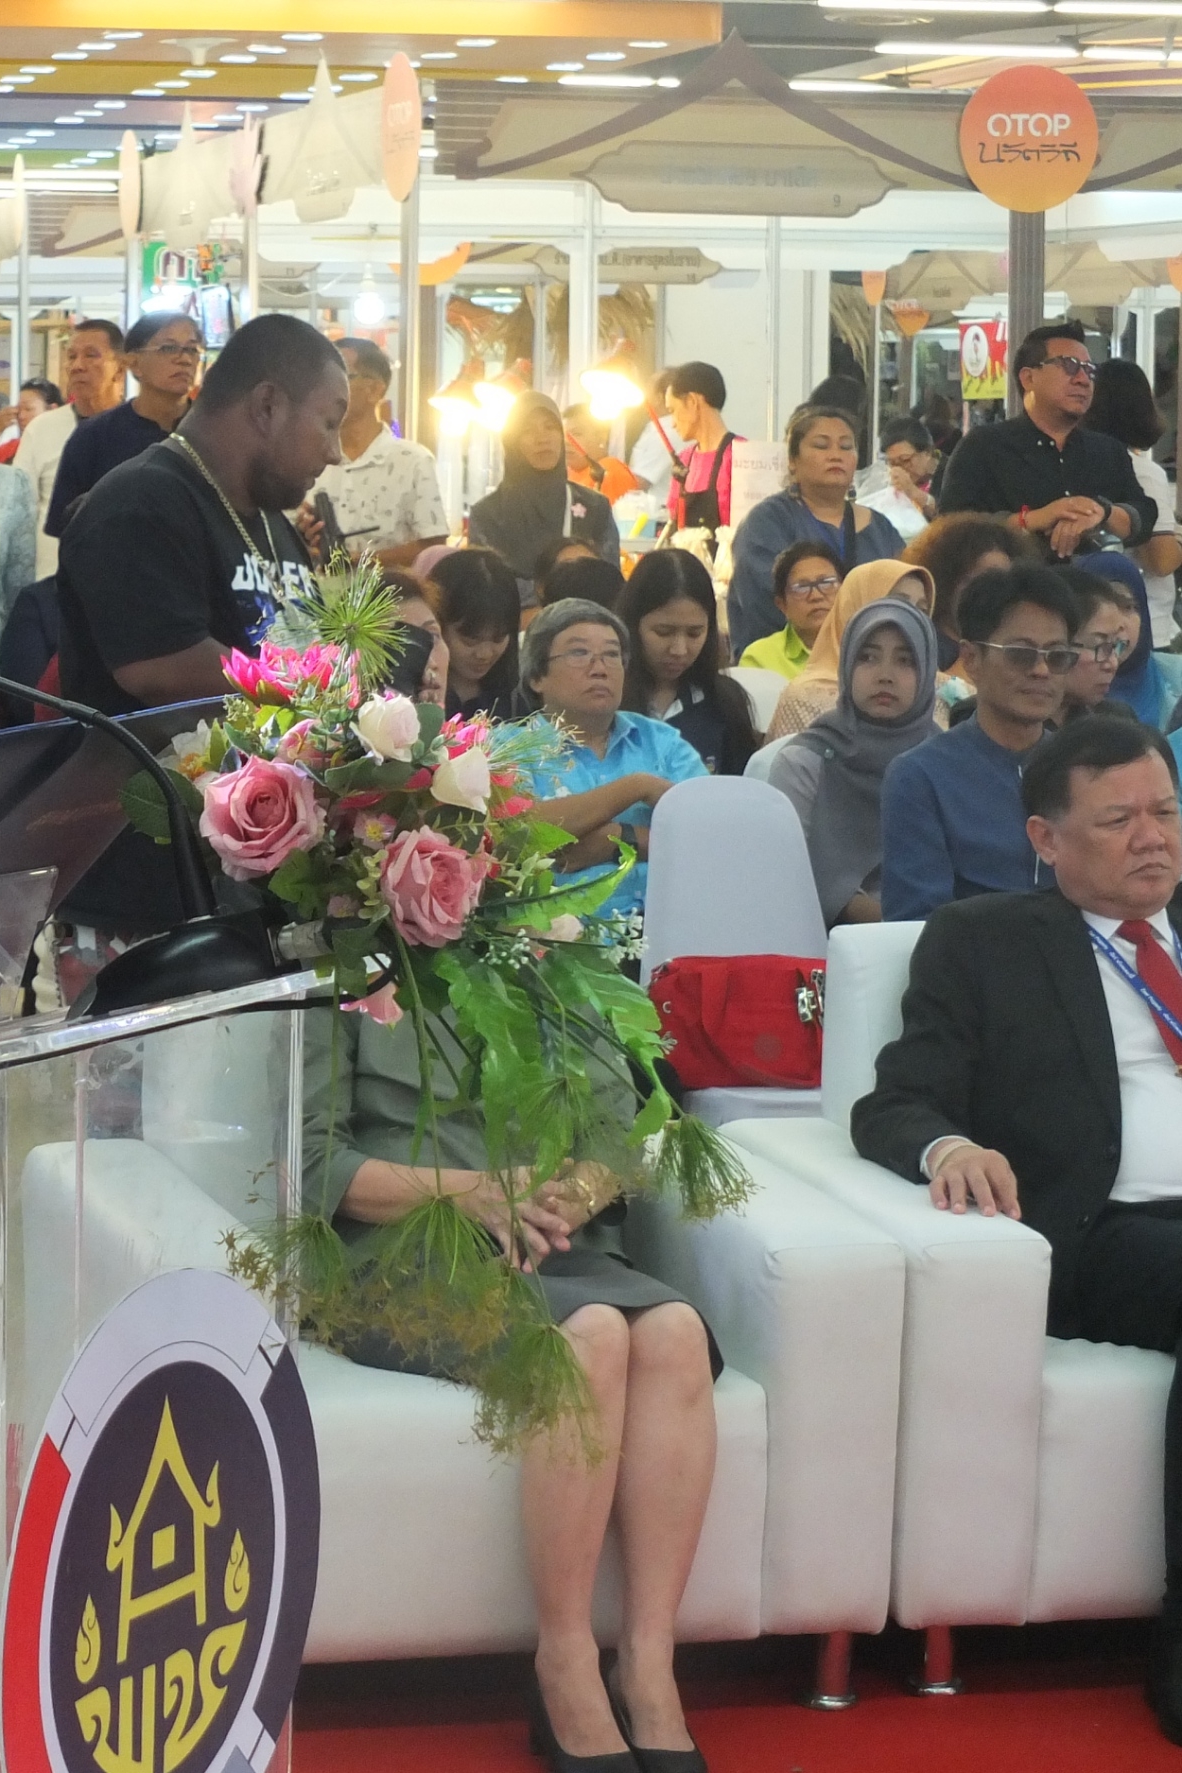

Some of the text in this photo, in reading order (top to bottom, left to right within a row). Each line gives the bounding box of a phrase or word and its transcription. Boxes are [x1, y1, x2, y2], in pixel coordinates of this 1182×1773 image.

[986, 113, 1071, 137] OTOP
[978, 142, 1081, 163] นวัตวิถี
